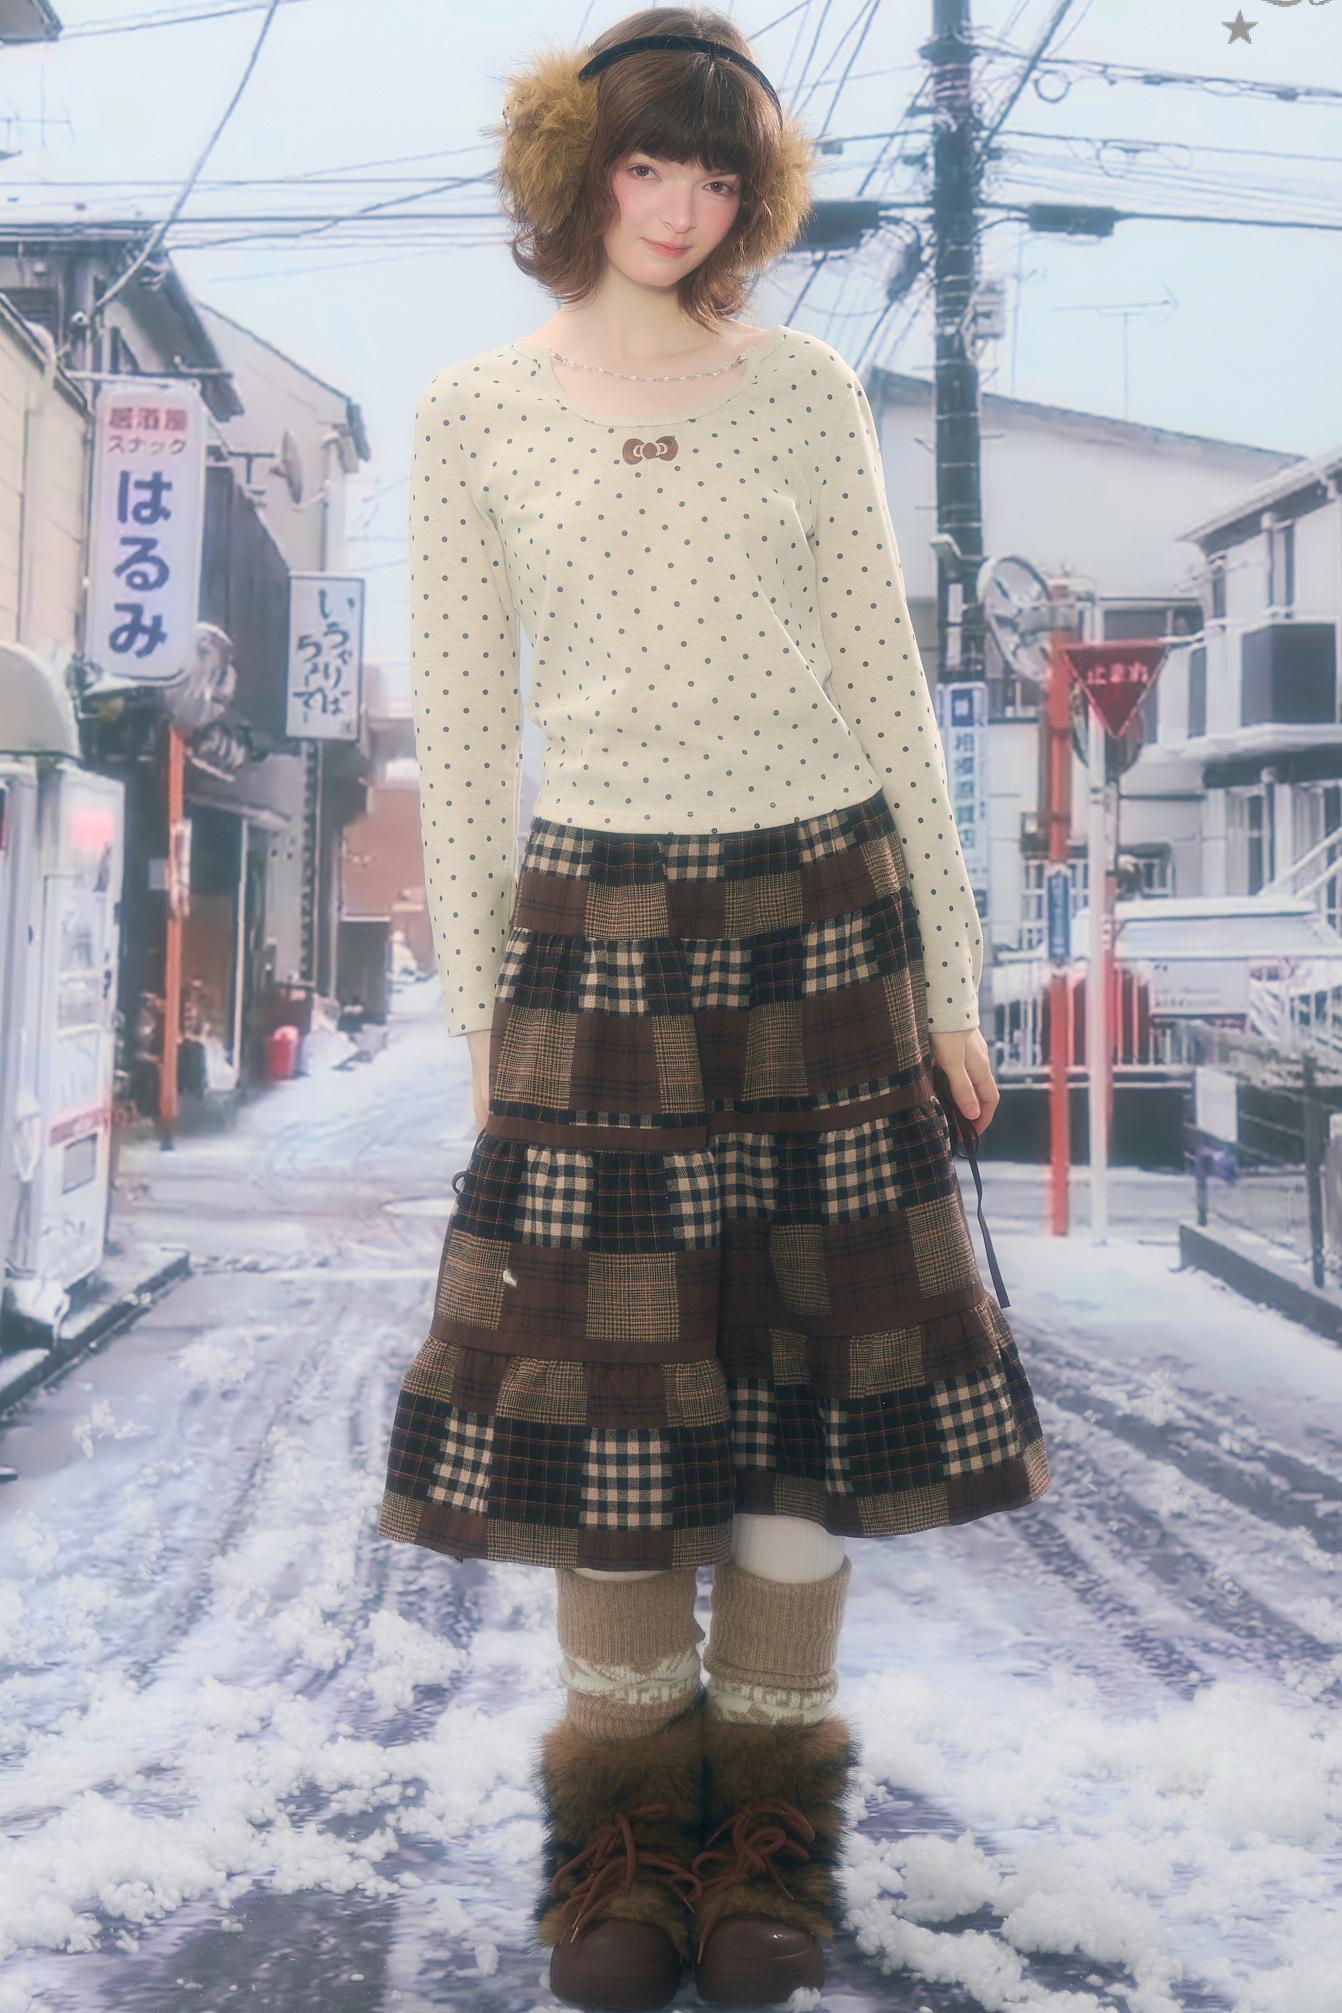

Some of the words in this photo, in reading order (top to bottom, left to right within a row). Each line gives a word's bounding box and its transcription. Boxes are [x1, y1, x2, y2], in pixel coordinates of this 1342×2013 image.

[108, 435, 187, 455] スナック
[108, 469, 173, 658] はるみ
